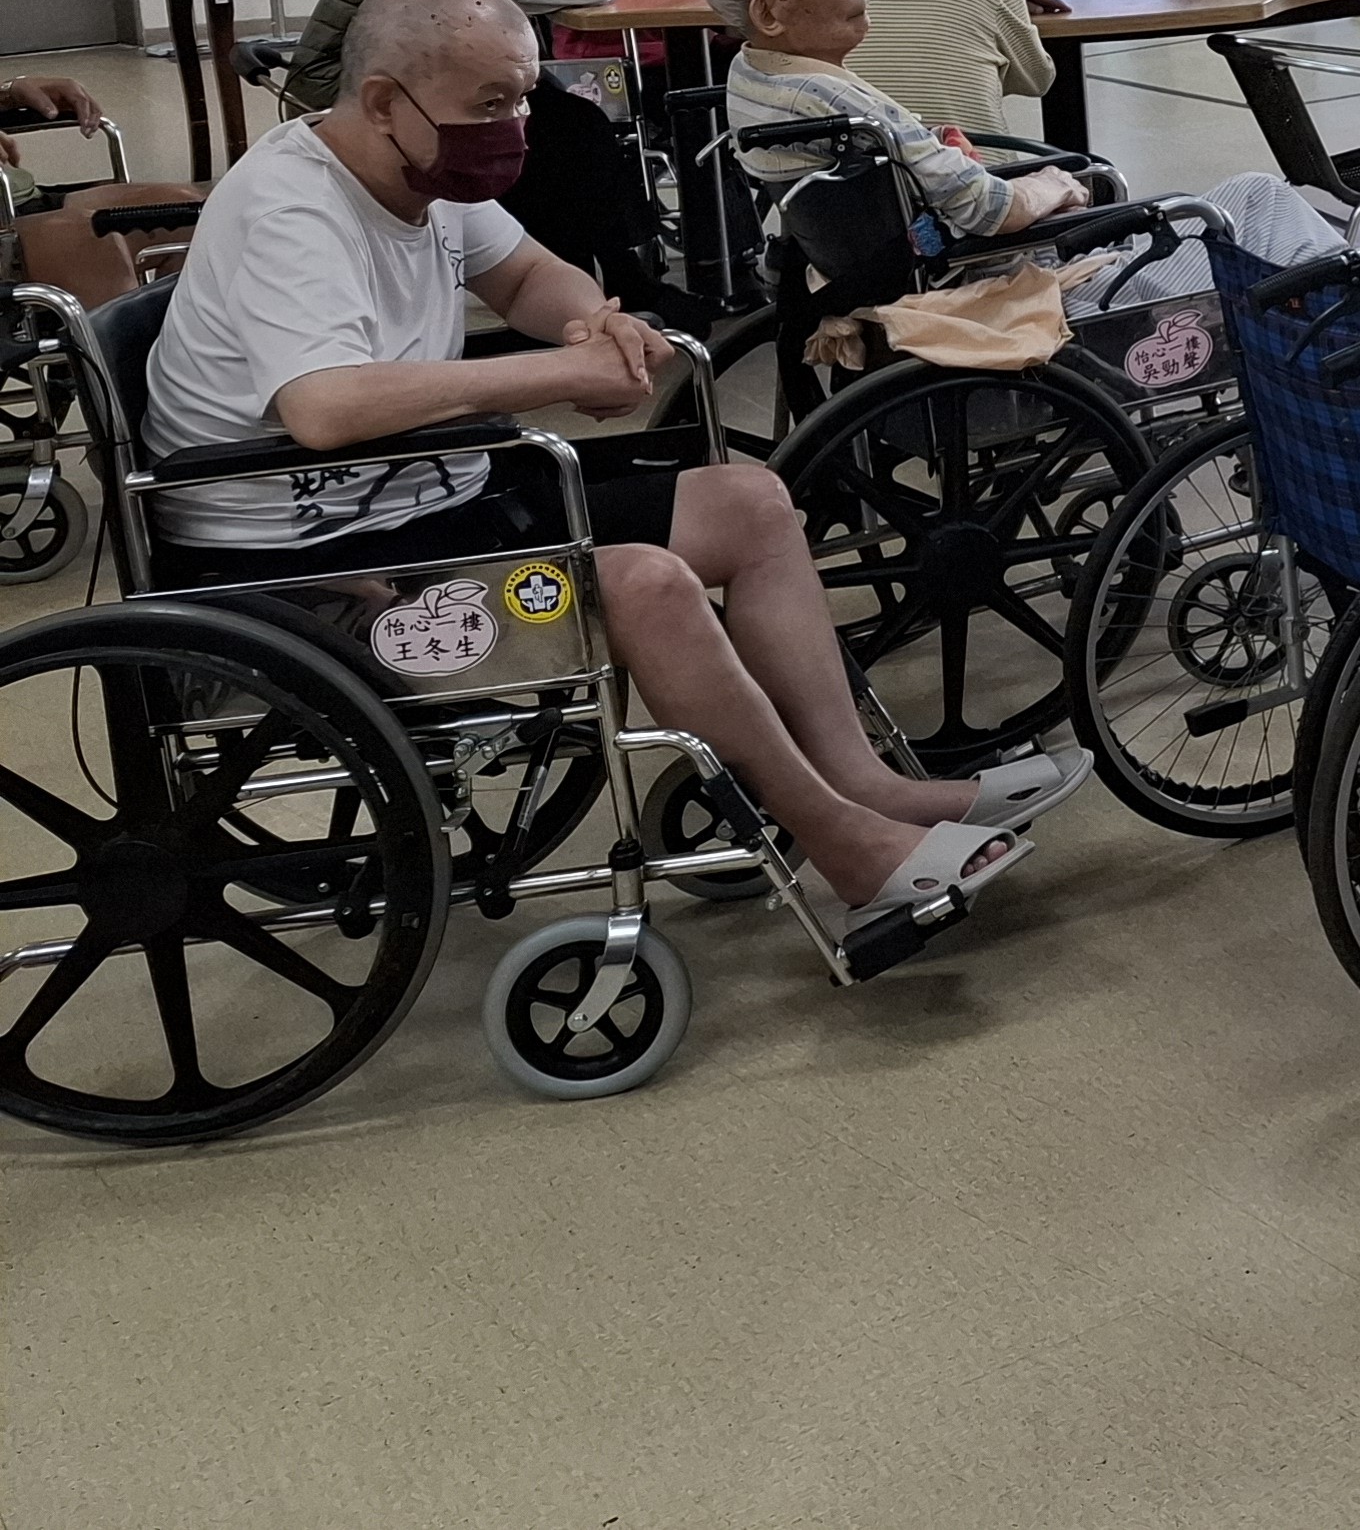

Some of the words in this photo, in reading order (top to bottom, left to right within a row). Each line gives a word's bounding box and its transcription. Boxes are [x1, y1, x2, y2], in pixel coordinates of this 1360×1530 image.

[1134, 335, 1201, 366] 怡心一樓
[1142, 351, 1200, 384] 吳勁聲
[383, 611, 485, 638] 怡心一樓
[392, 635, 480, 663] 王冬生
